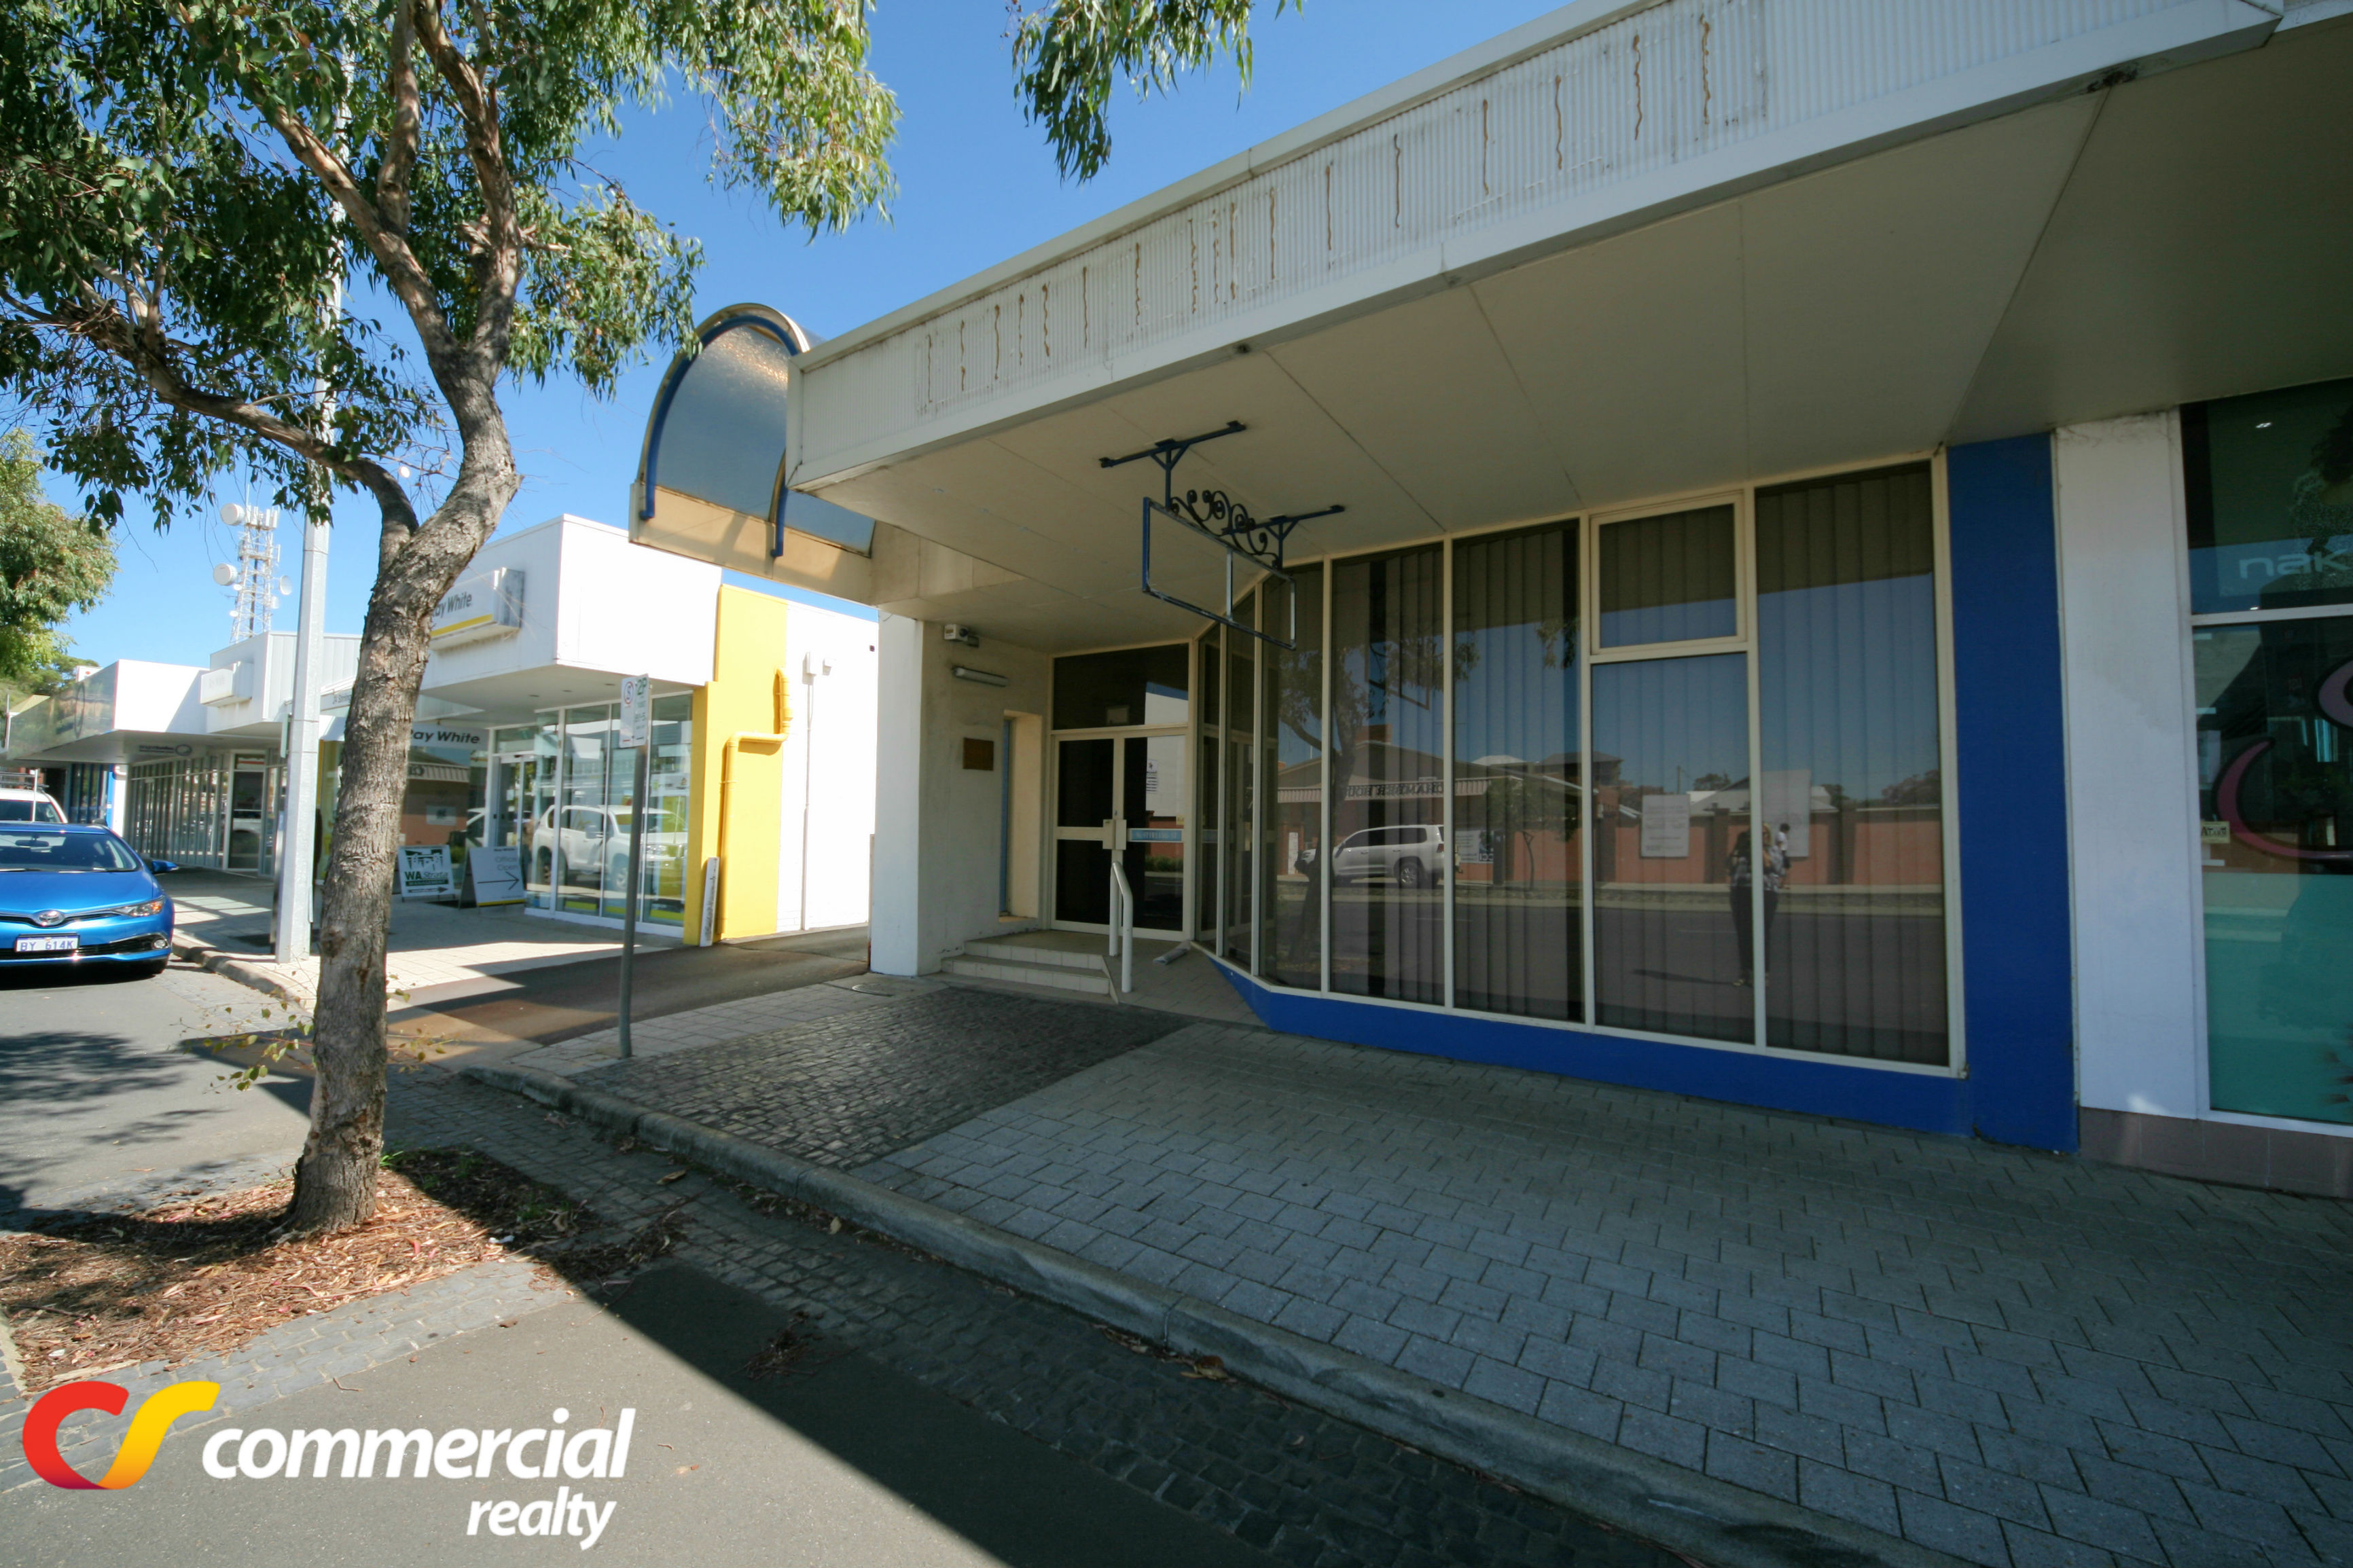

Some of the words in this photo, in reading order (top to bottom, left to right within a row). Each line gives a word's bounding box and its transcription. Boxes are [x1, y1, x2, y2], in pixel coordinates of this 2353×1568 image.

[433, 601, 446, 618] ay
[448, 591, 473, 613] White
[637, 677, 647, 695] 2P
[437, 731, 480, 744] White
[404, 871, 422, 880] WA
[20, 941, 37, 951] BY
[45, 941, 74, 950] 614K
